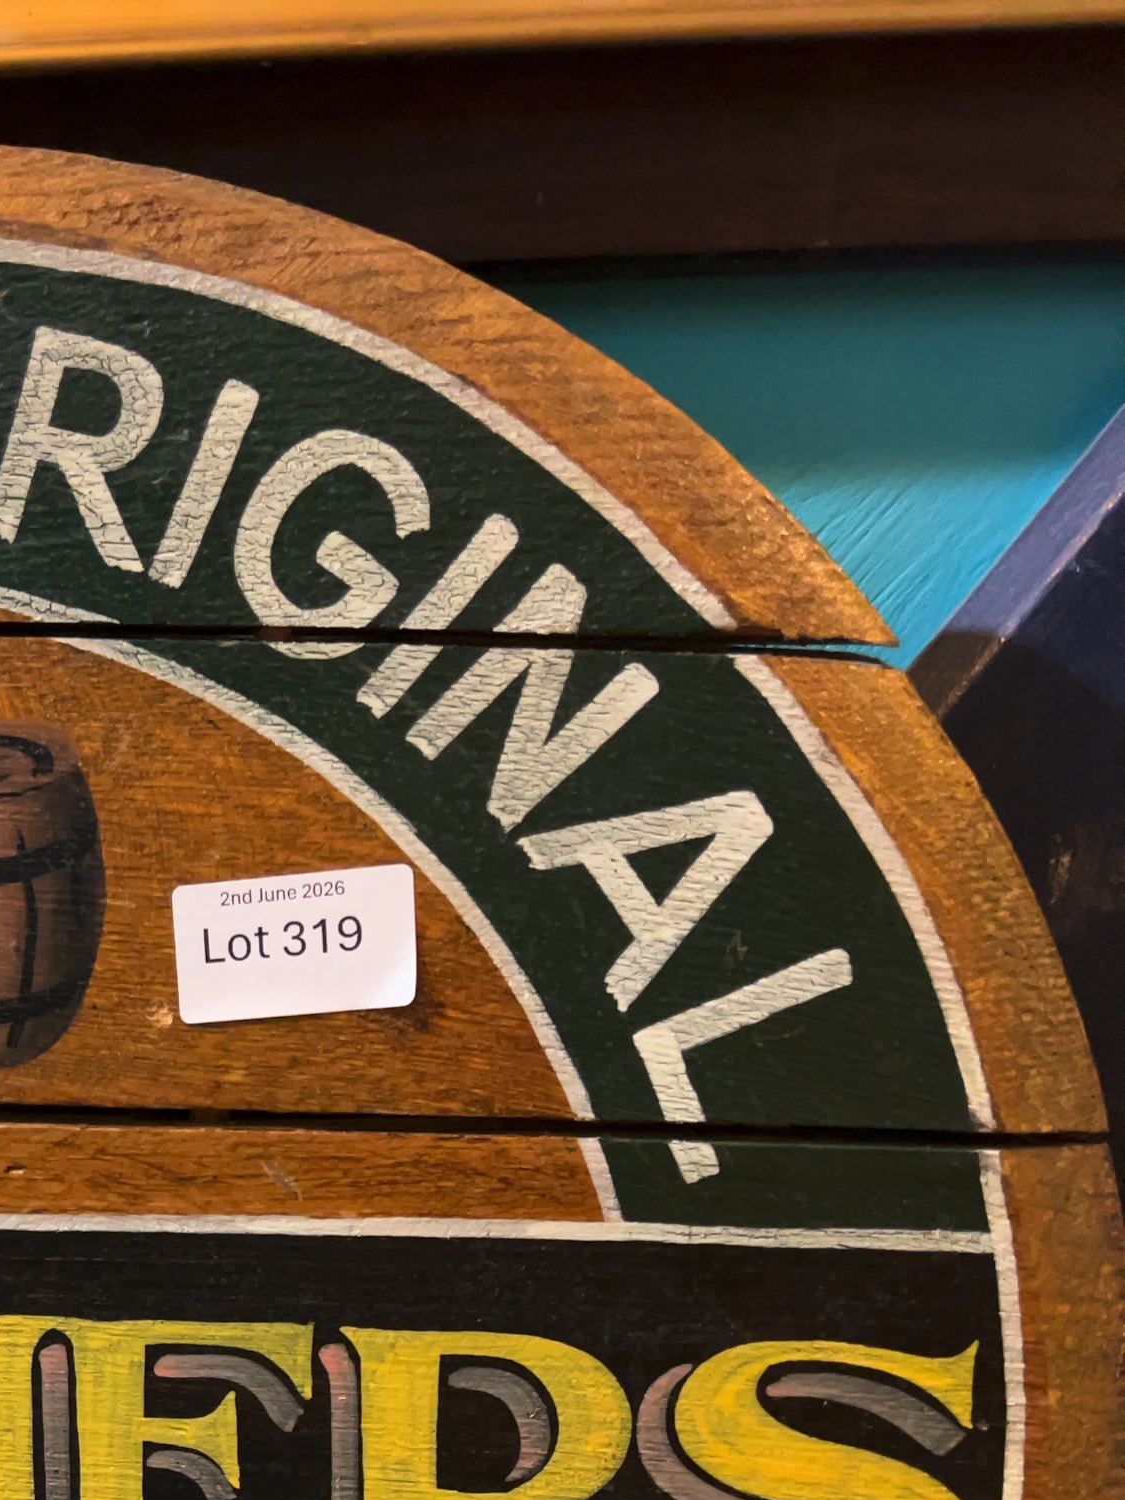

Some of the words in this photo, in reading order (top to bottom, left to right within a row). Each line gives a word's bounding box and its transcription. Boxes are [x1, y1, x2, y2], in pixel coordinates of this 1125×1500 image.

[220, 889, 252, 906] 2nd
[258, 887, 297, 903] June
[302, 880, 345, 899] 2026
[203, 926, 271, 964] Lot
[282, 915, 363, 957] 319
